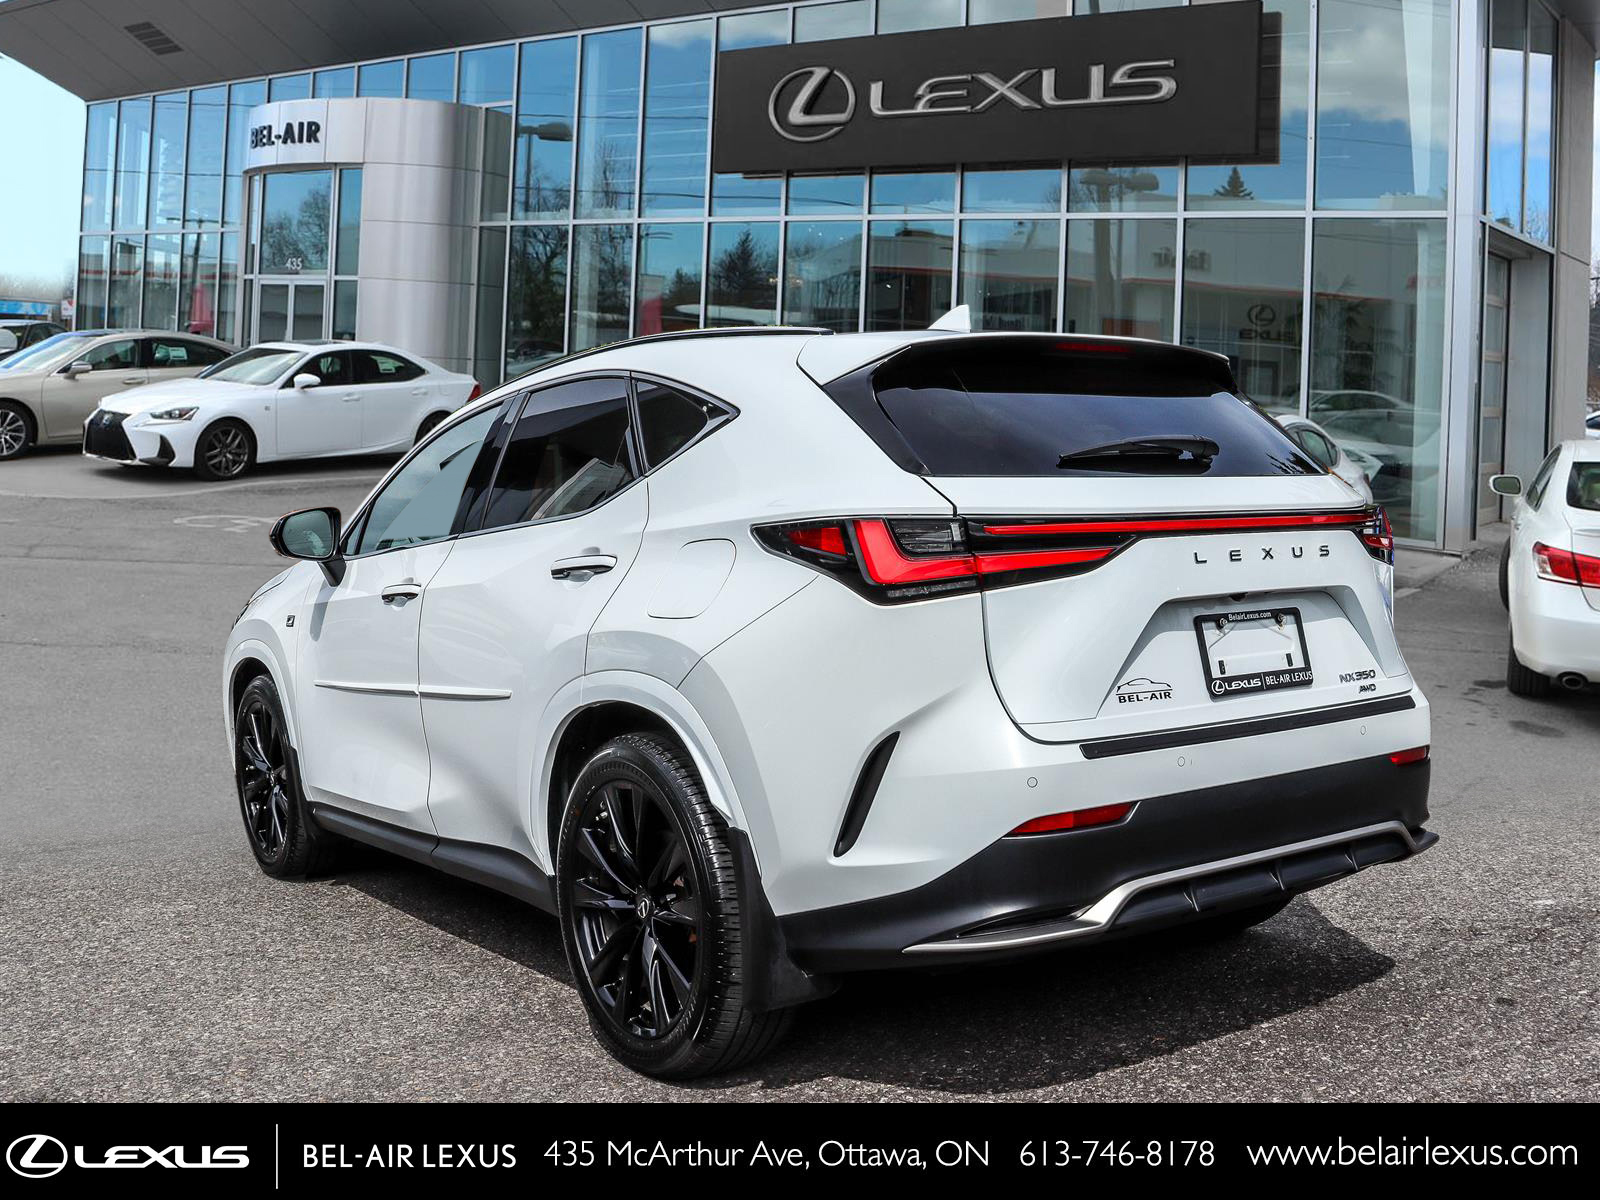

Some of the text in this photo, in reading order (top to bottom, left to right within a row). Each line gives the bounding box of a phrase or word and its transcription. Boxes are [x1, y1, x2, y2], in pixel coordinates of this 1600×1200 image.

[869, 59, 1177, 117] LEXUS
[250, 120, 321, 149] BEL-AIR
[285, 257, 303, 271] 435
[1193, 544, 1331, 565] LEXUS
[1228, 611, 1272, 621] BelairLexus.com
[1225, 671, 1313, 690] LEXUS BEL-AIR LEXUS
[1358, 683, 1377, 694] AWD
[1118, 691, 1172, 704] BEL-AIR
